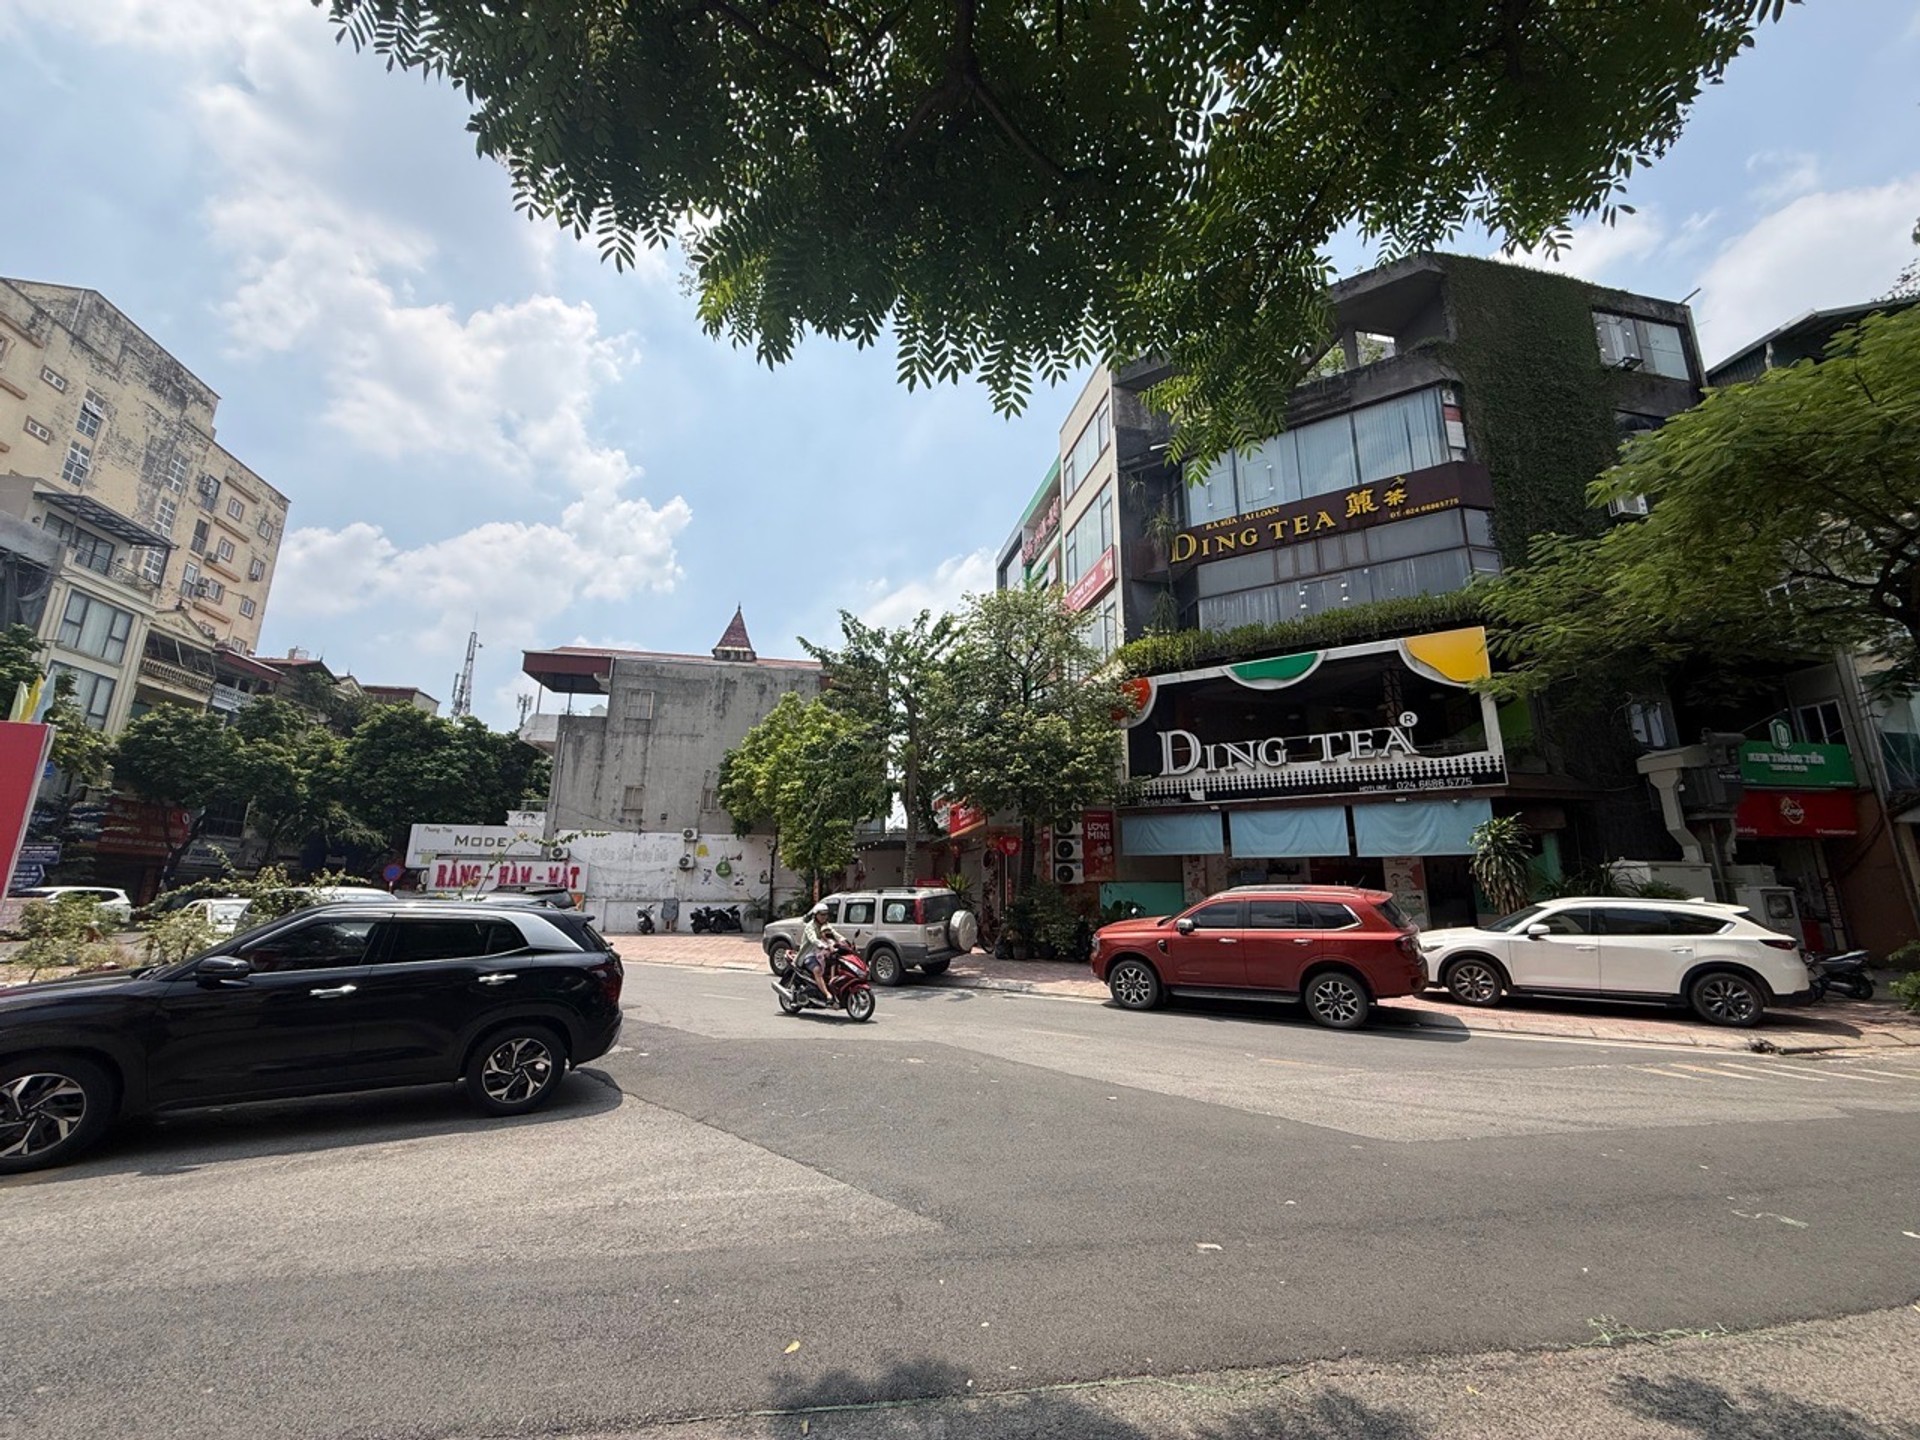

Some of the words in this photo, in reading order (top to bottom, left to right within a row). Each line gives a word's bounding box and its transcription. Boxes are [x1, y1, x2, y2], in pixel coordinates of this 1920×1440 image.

[1170, 527, 1258, 563] DING
[1268, 511, 1336, 541] TEA
[1157, 728, 1289, 777] DING
[1309, 725, 1420, 764] TEA
[1396, 781, 1416, 790] 024
[1088, 822, 1109, 830] LOVE
[1088, 831, 1110, 839] MINI
[434, 857, 483, 889] RĂNG
